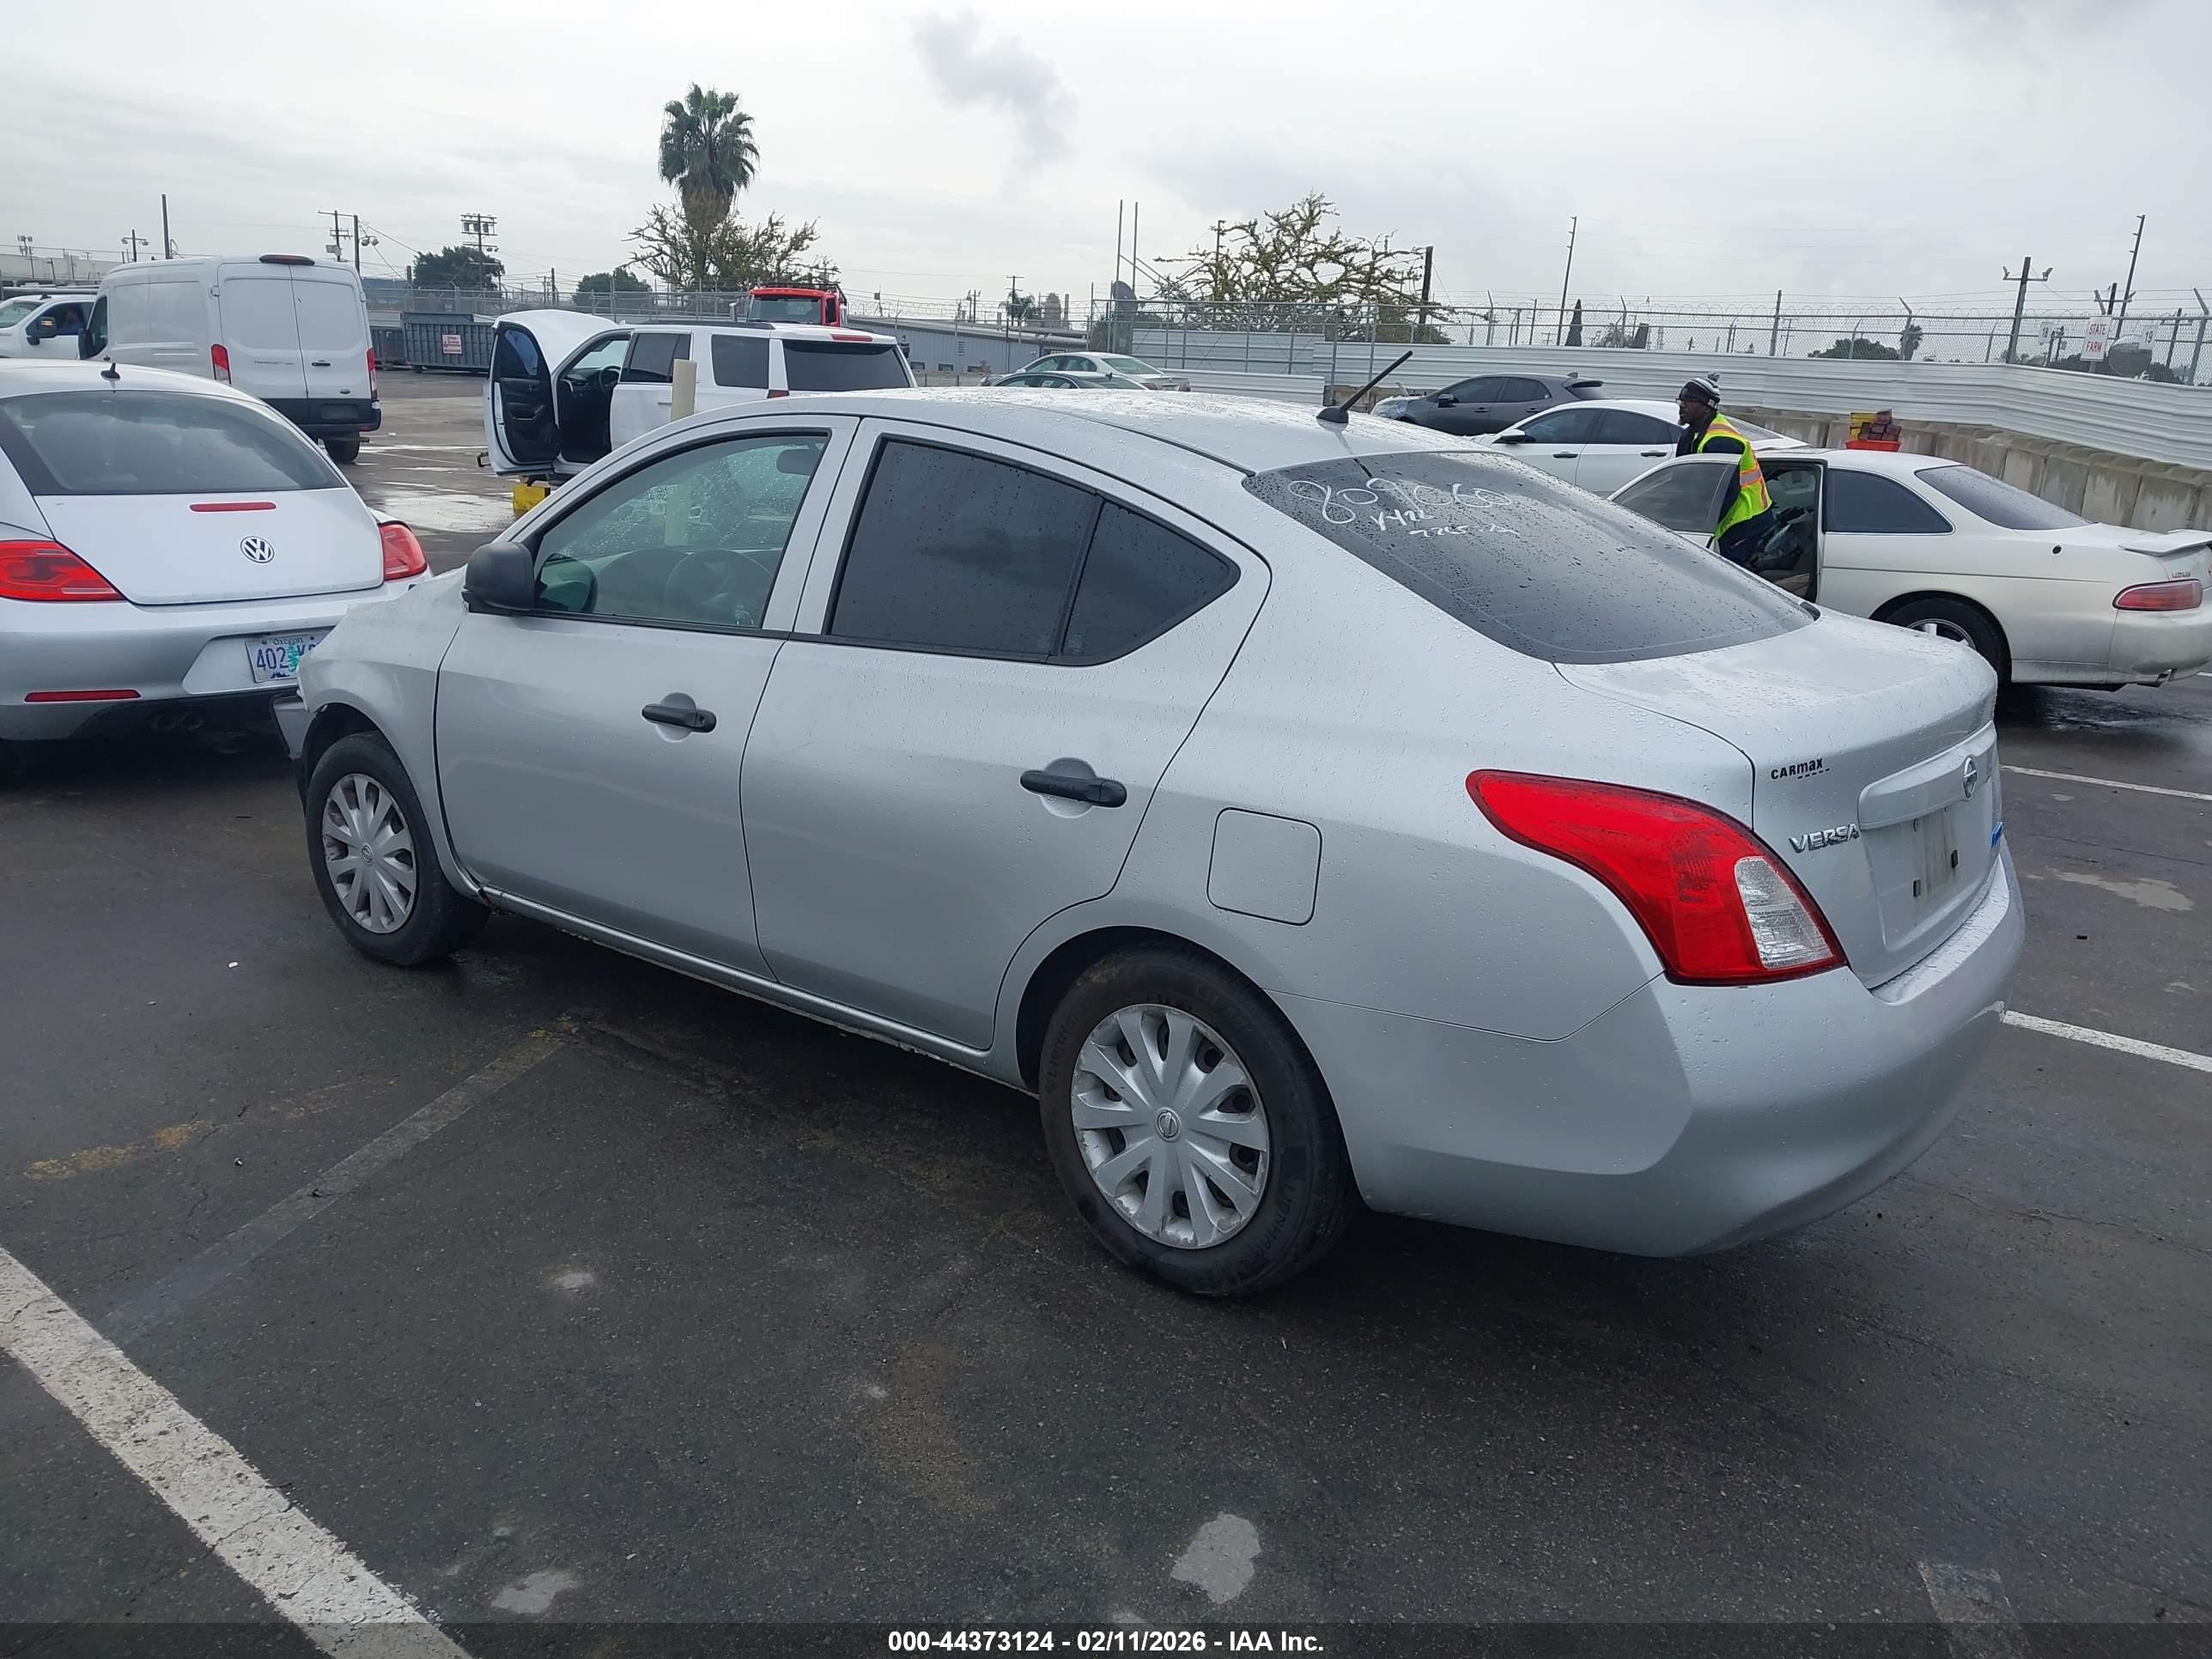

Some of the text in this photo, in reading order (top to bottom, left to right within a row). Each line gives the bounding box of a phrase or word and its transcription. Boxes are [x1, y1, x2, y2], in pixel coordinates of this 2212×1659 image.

[2042, 326, 2049, 339] 18
[2088, 323, 2107, 336] STATE
[2145, 330, 2154, 343] 19
[2087, 341, 2102, 353] FARM
[272, 636, 304, 646] Oregon
[257, 647, 289, 671] 402
[1788, 823, 1861, 854] VERSA
